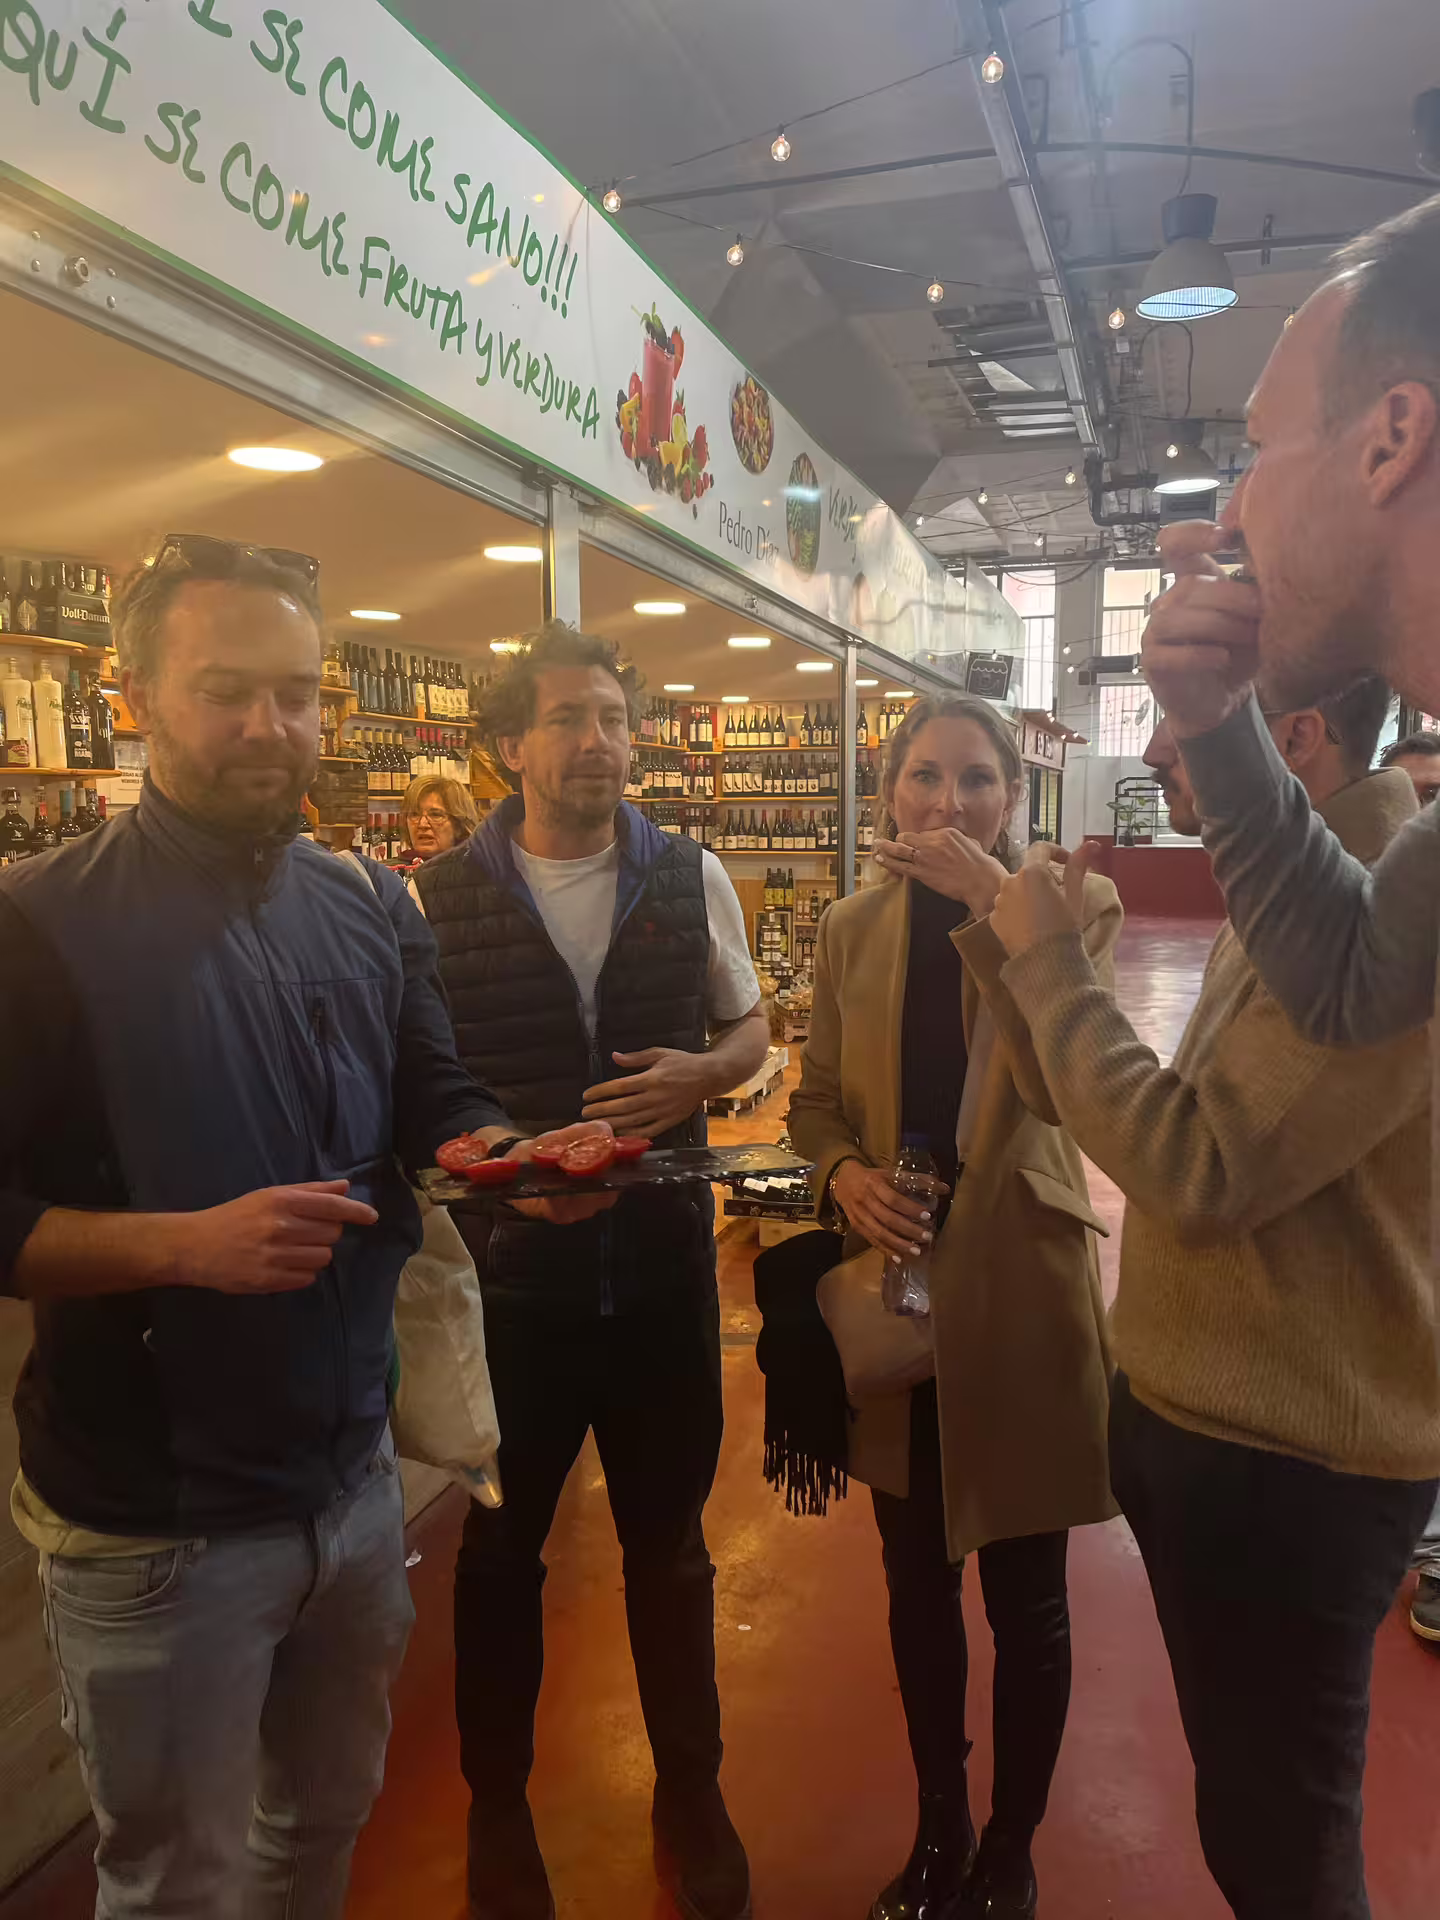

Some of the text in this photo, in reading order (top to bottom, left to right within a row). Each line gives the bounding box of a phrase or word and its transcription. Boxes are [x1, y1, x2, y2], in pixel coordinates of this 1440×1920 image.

[144, 102, 206, 184] SE
[220, 141, 349, 276] COME
[359, 237, 467, 354] FRUTA
[499, 331, 600, 439] VERDURA
[250, 9, 578, 319] SE COME SANO!!!
[719, 500, 753, 555] Pedro
